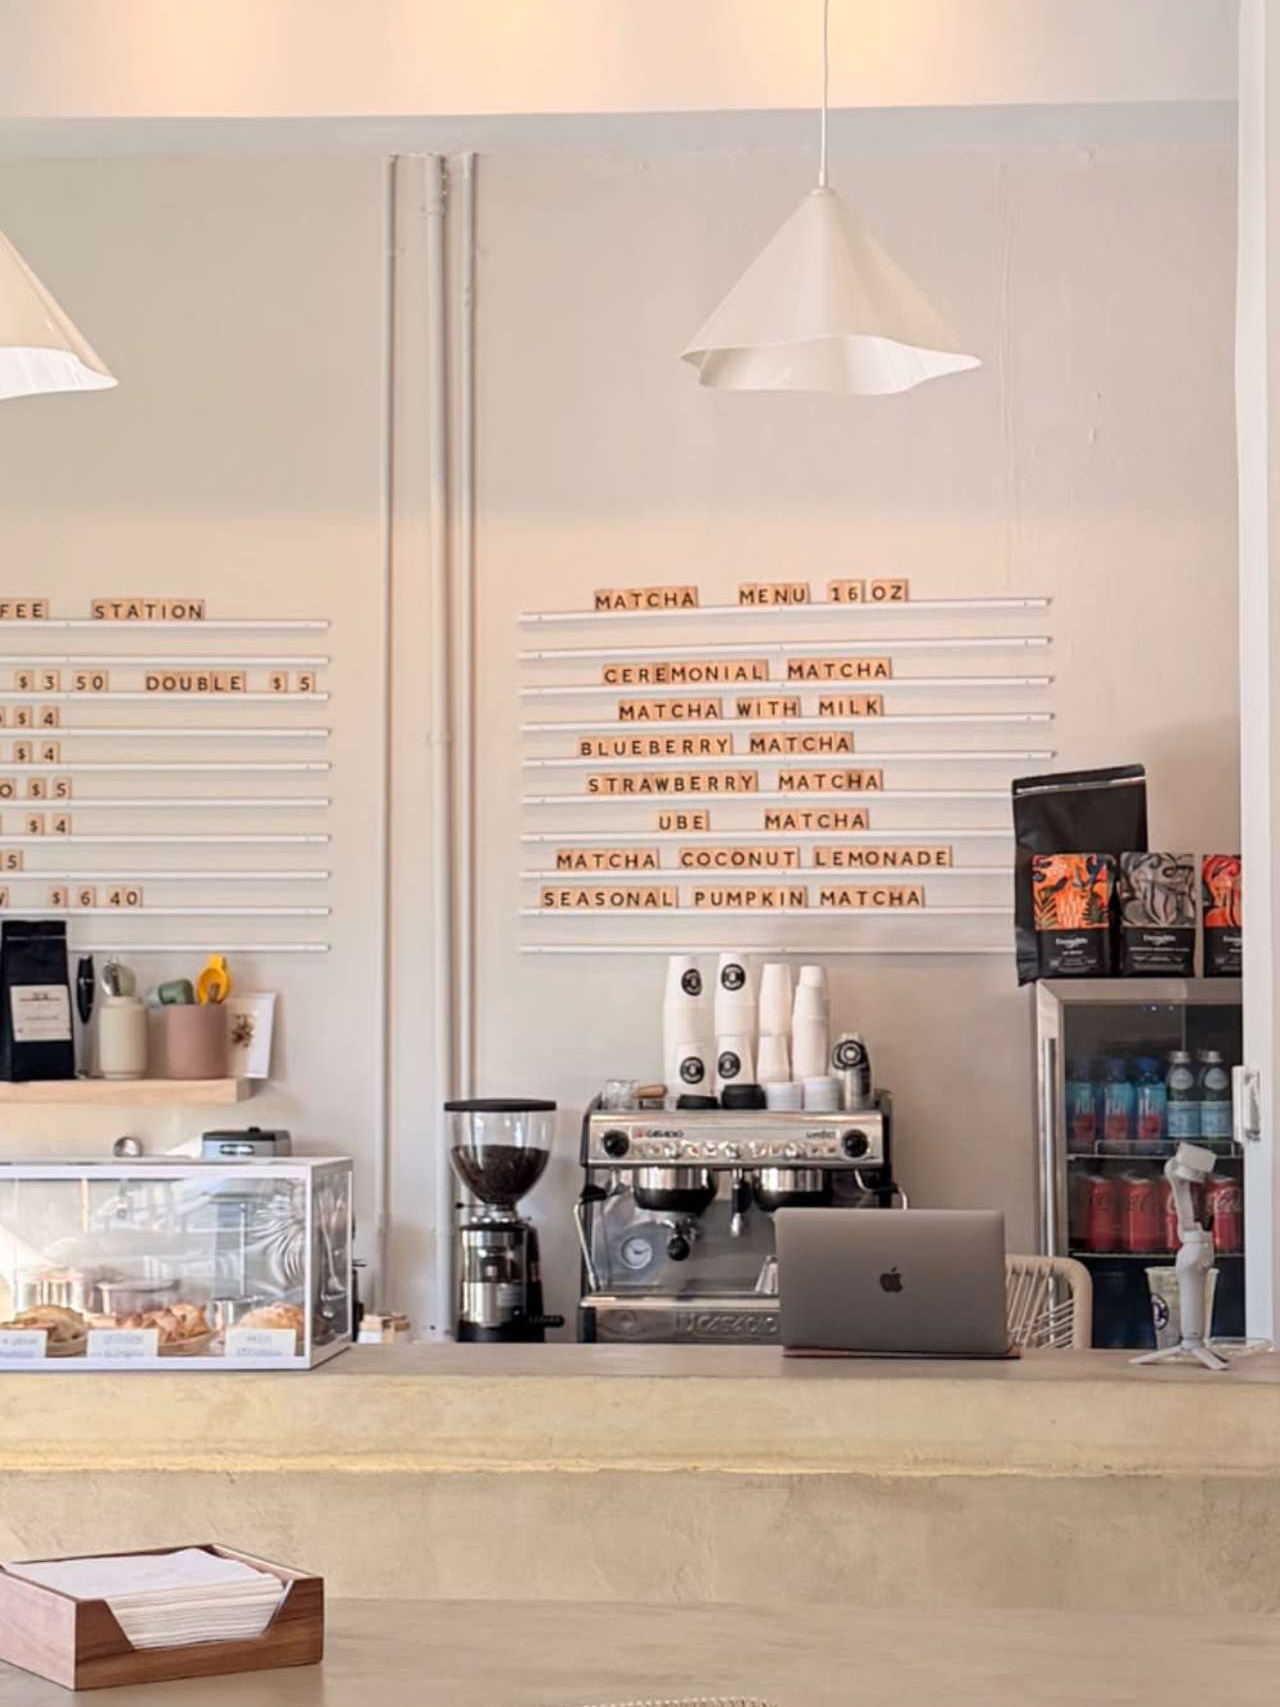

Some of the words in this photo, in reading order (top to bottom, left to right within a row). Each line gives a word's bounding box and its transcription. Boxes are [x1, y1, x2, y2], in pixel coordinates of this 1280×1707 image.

[595, 591, 695, 609] MATCHA
[739, 588, 805, 604] MENU
[94, 603, 202, 619] STATION
[604, 666, 763, 684] CEREMONIAL
[788, 663, 887, 679] MATCHA
[146, 676, 241, 692] DOUBLE
[619, 703, 718, 721] MATCHA
[737, 701, 797, 717] WITH
[819, 700, 877, 715] MILK
[581, 738, 727, 756] BLUEBERRY
[750, 736, 849, 753] MATCHA
[588, 775, 753, 793] STRAWBERRY
[778, 773, 878, 790] MATCHA
[659, 815, 703, 830] UBE
[765, 813, 865, 829] MATCHA
[556, 853, 655, 869] MATCHA
[681, 851, 795, 868] COCONUT
[815, 851, 946, 867] LEMONADE
[544, 891, 672, 907] SEASONAL
[695, 891, 803, 906] PUMPKIN
[820, 890, 920, 906] MATCHA
